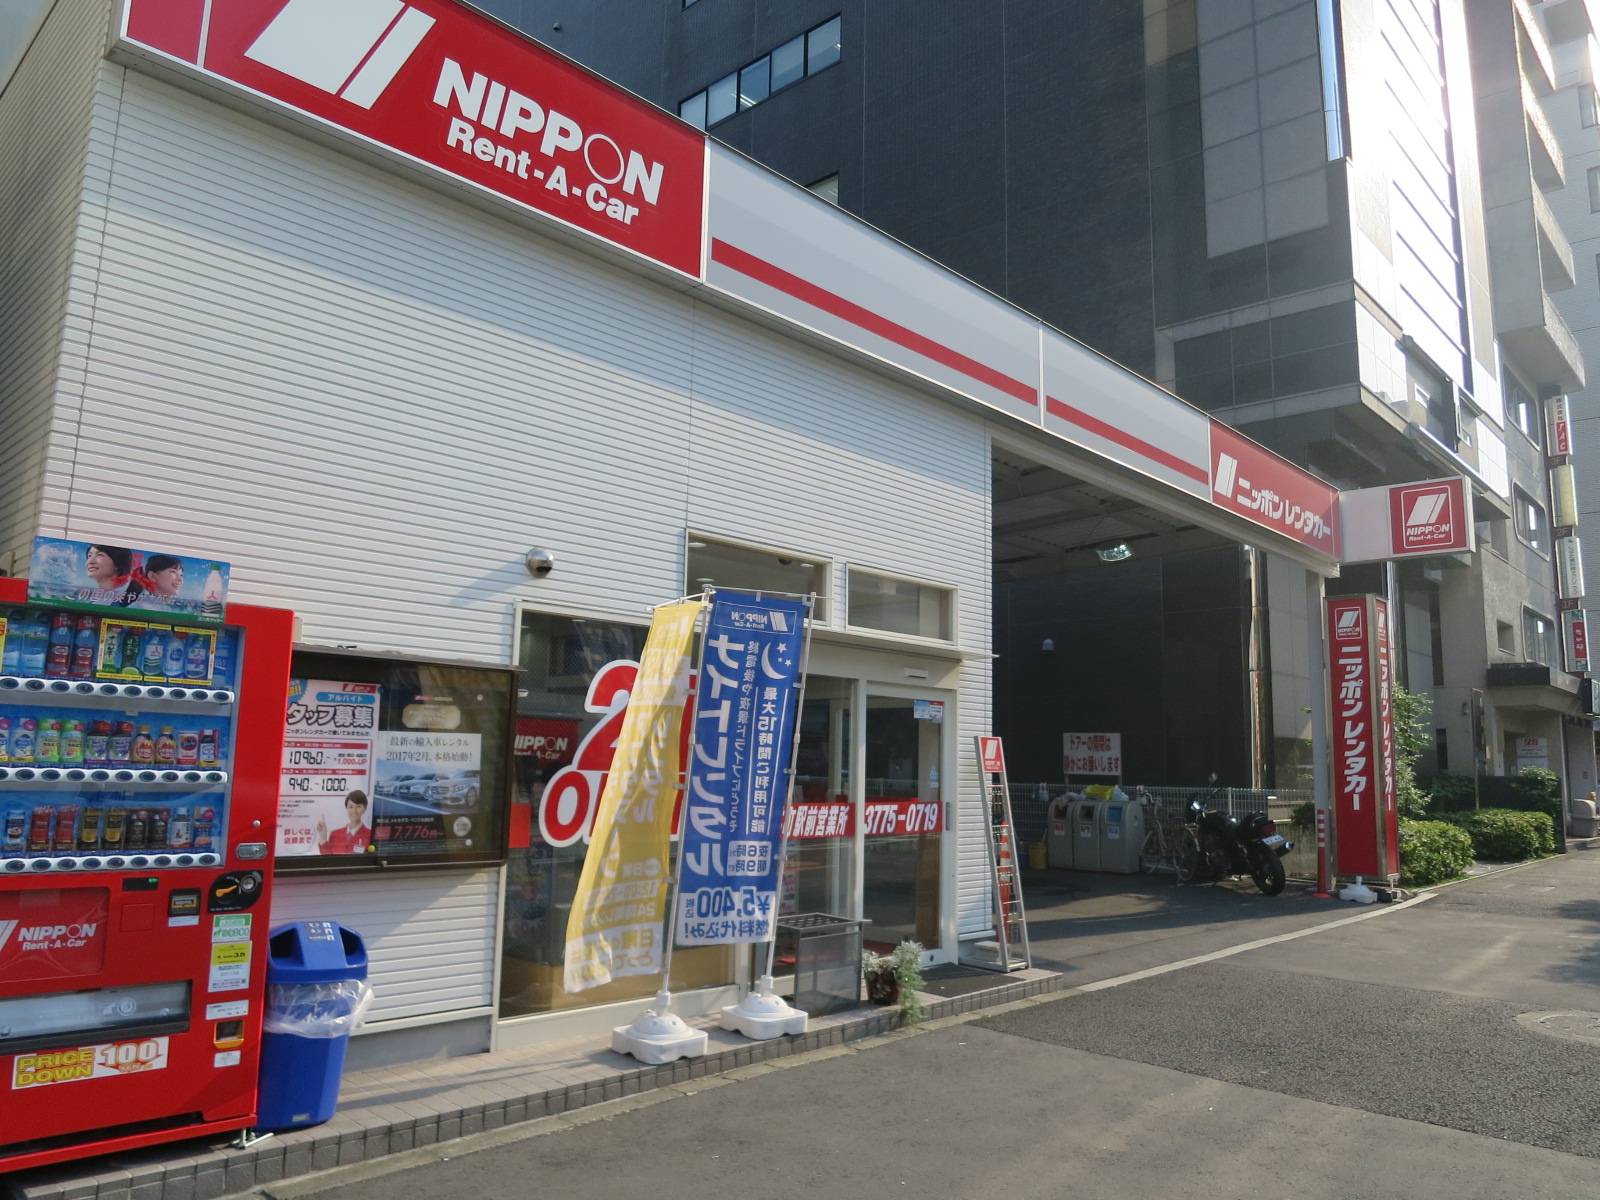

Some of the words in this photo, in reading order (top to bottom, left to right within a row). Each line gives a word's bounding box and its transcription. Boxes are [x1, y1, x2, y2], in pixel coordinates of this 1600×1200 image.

[433, 57, 664, 205] NIPPON
[1406, 523, 1450, 537] NIPPON
[327, 693, 364, 702] アルバイト
[389, 736, 469, 747] 最新の輸入車レンタル
[18, 923, 97, 941] NIPPON
[18, 1050, 94, 1071] PRICE
[101, 1040, 159, 1066] 100
[17, 1064, 93, 1086] DOWN
